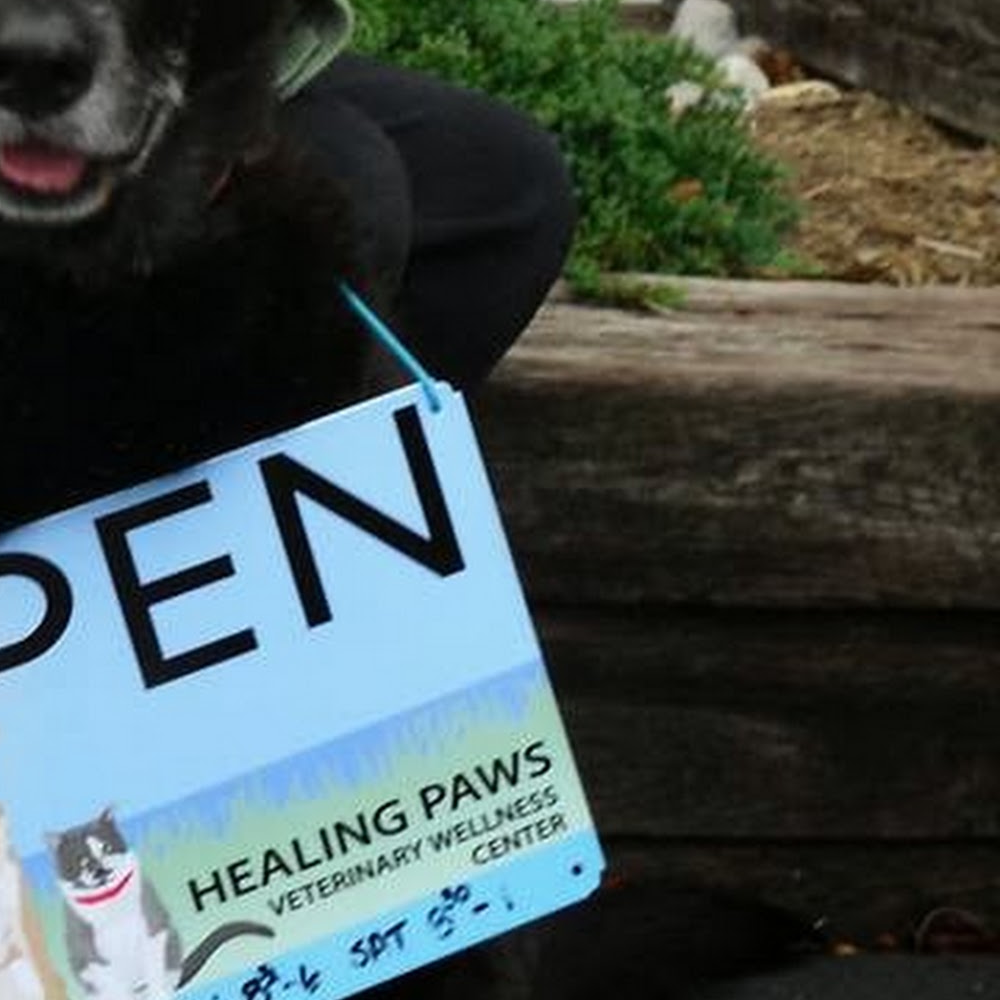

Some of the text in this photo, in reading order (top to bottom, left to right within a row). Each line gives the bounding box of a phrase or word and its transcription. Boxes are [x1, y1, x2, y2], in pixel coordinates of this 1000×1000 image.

[187, 741, 552, 911] HEALING PAWS
[268, 786, 560, 915] VETERINARY WELLNESS
[471, 813, 567, 866] CENTER
